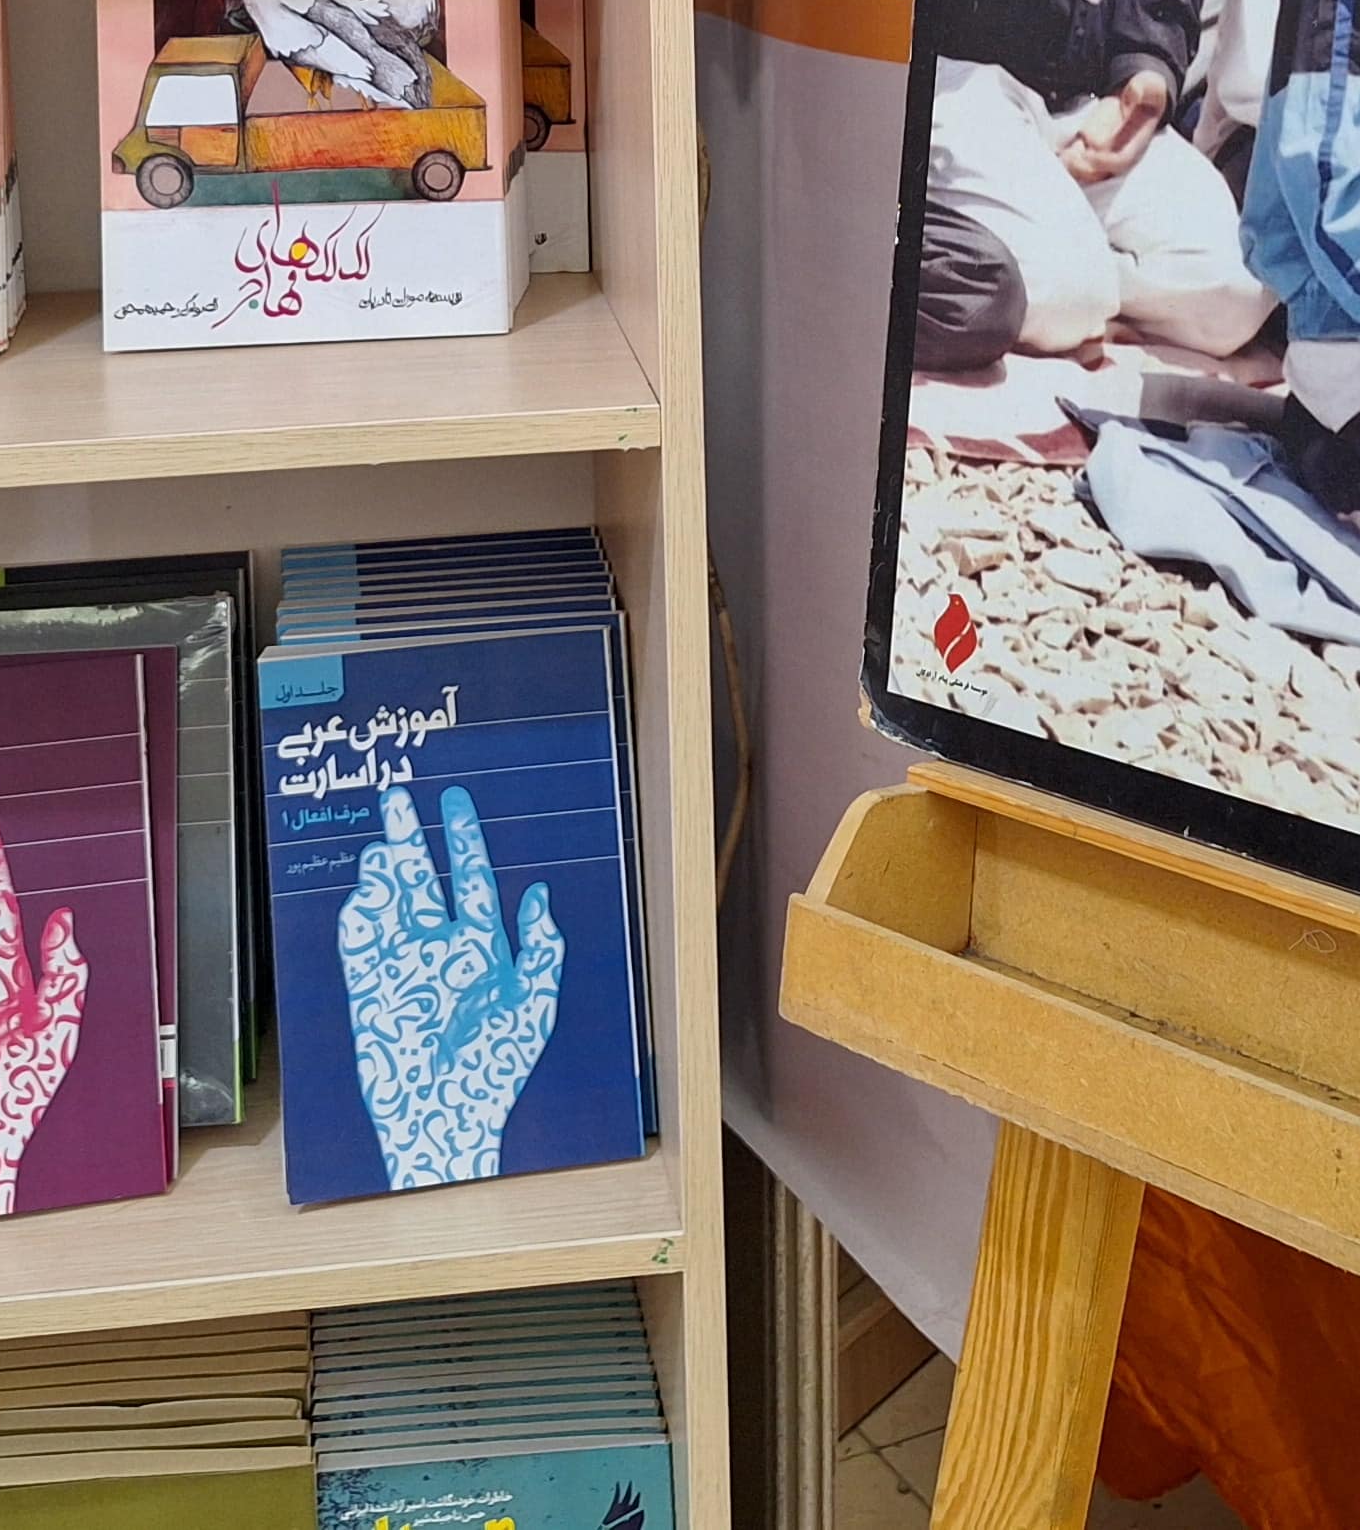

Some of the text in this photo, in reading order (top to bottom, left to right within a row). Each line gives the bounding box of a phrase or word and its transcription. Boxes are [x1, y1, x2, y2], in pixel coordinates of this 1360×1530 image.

[295, 681, 339, 698] جلد
[349, 685, 459, 751] آموزش
[279, 748, 413, 800] در اسارت
[291, 806, 333, 830] افعال
[335, 804, 370, 827] صرف
